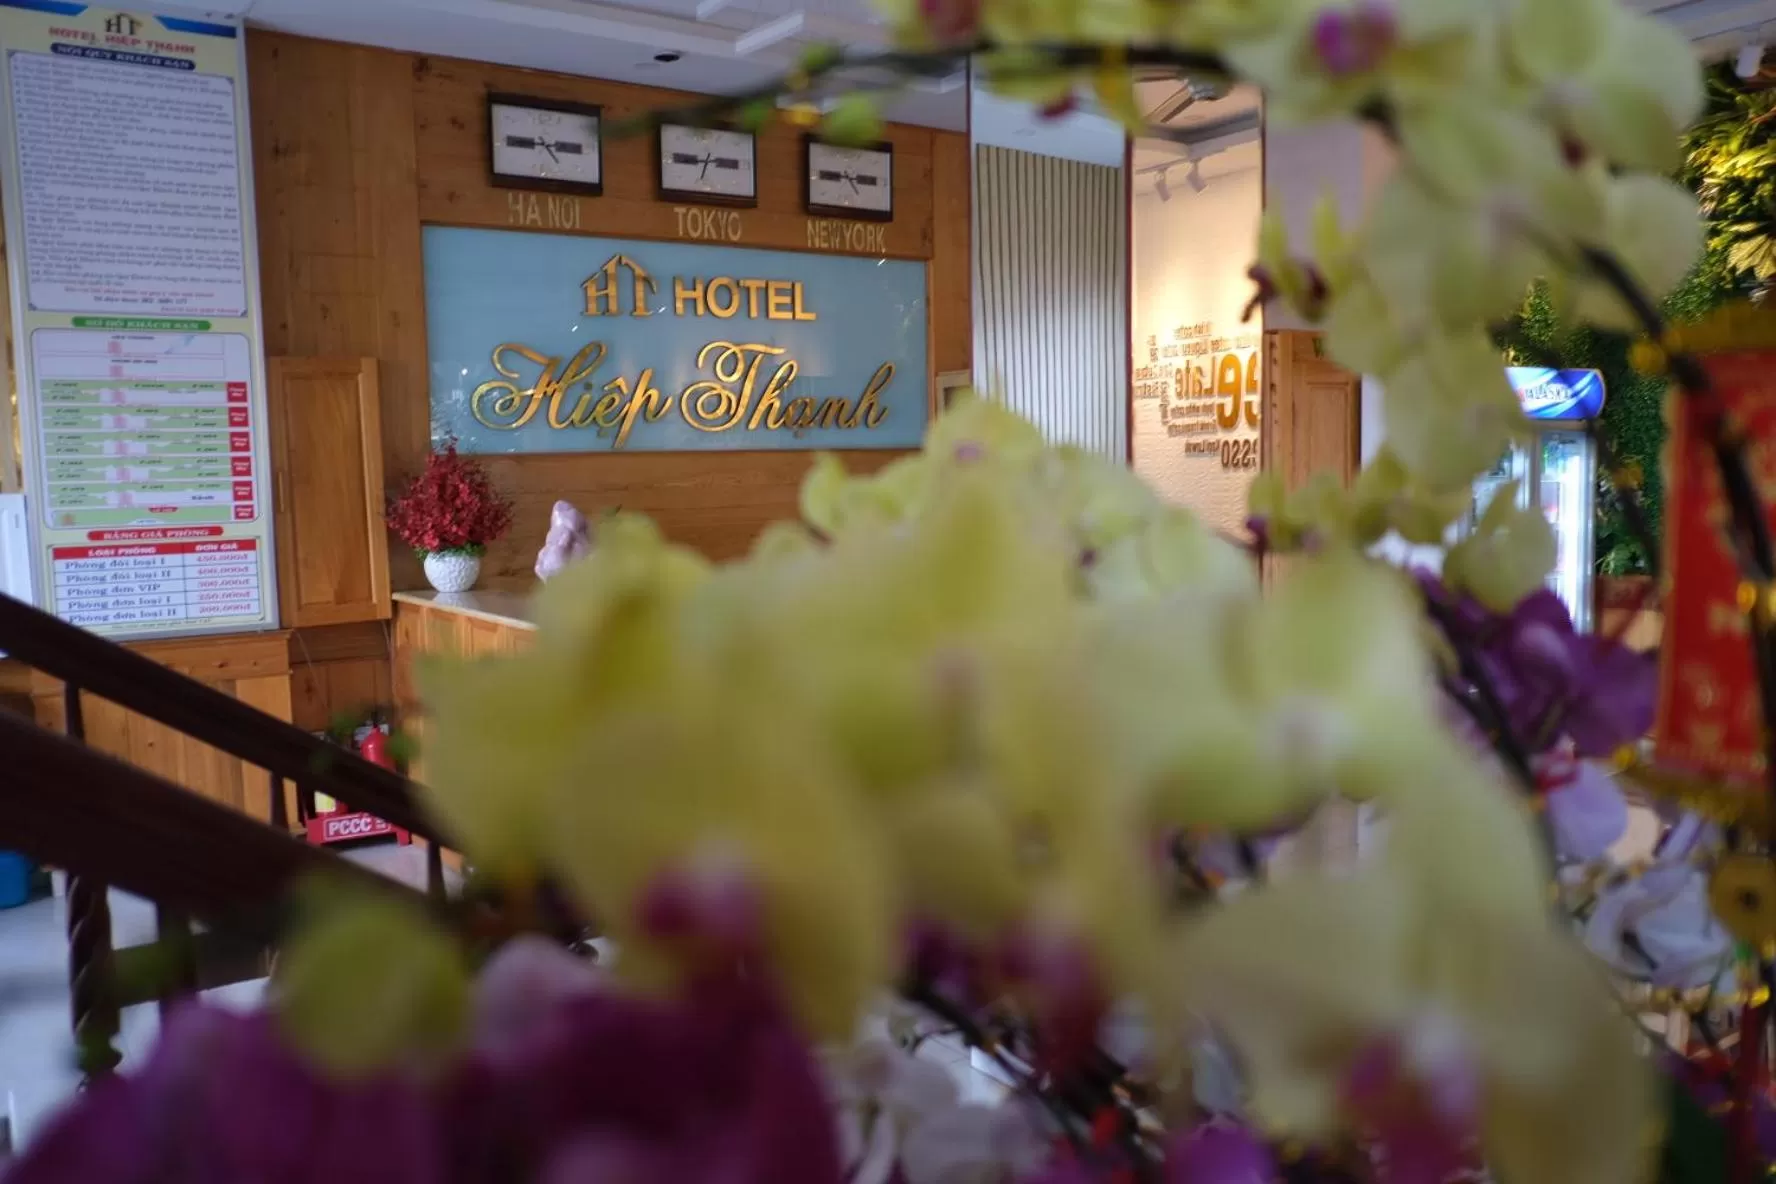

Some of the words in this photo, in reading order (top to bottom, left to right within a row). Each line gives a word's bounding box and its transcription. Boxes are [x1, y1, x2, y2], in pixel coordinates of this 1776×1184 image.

[49, 26, 96, 42] HOTEL
[673, 207, 742, 242] TOKYO
[806, 219, 886, 252] NEWYORK
[673, 276, 817, 322] HOTEL
[471, 340, 673, 449] Hiệp
[138, 583, 161, 591] VIP
[328, 817, 373, 836] PCCC
